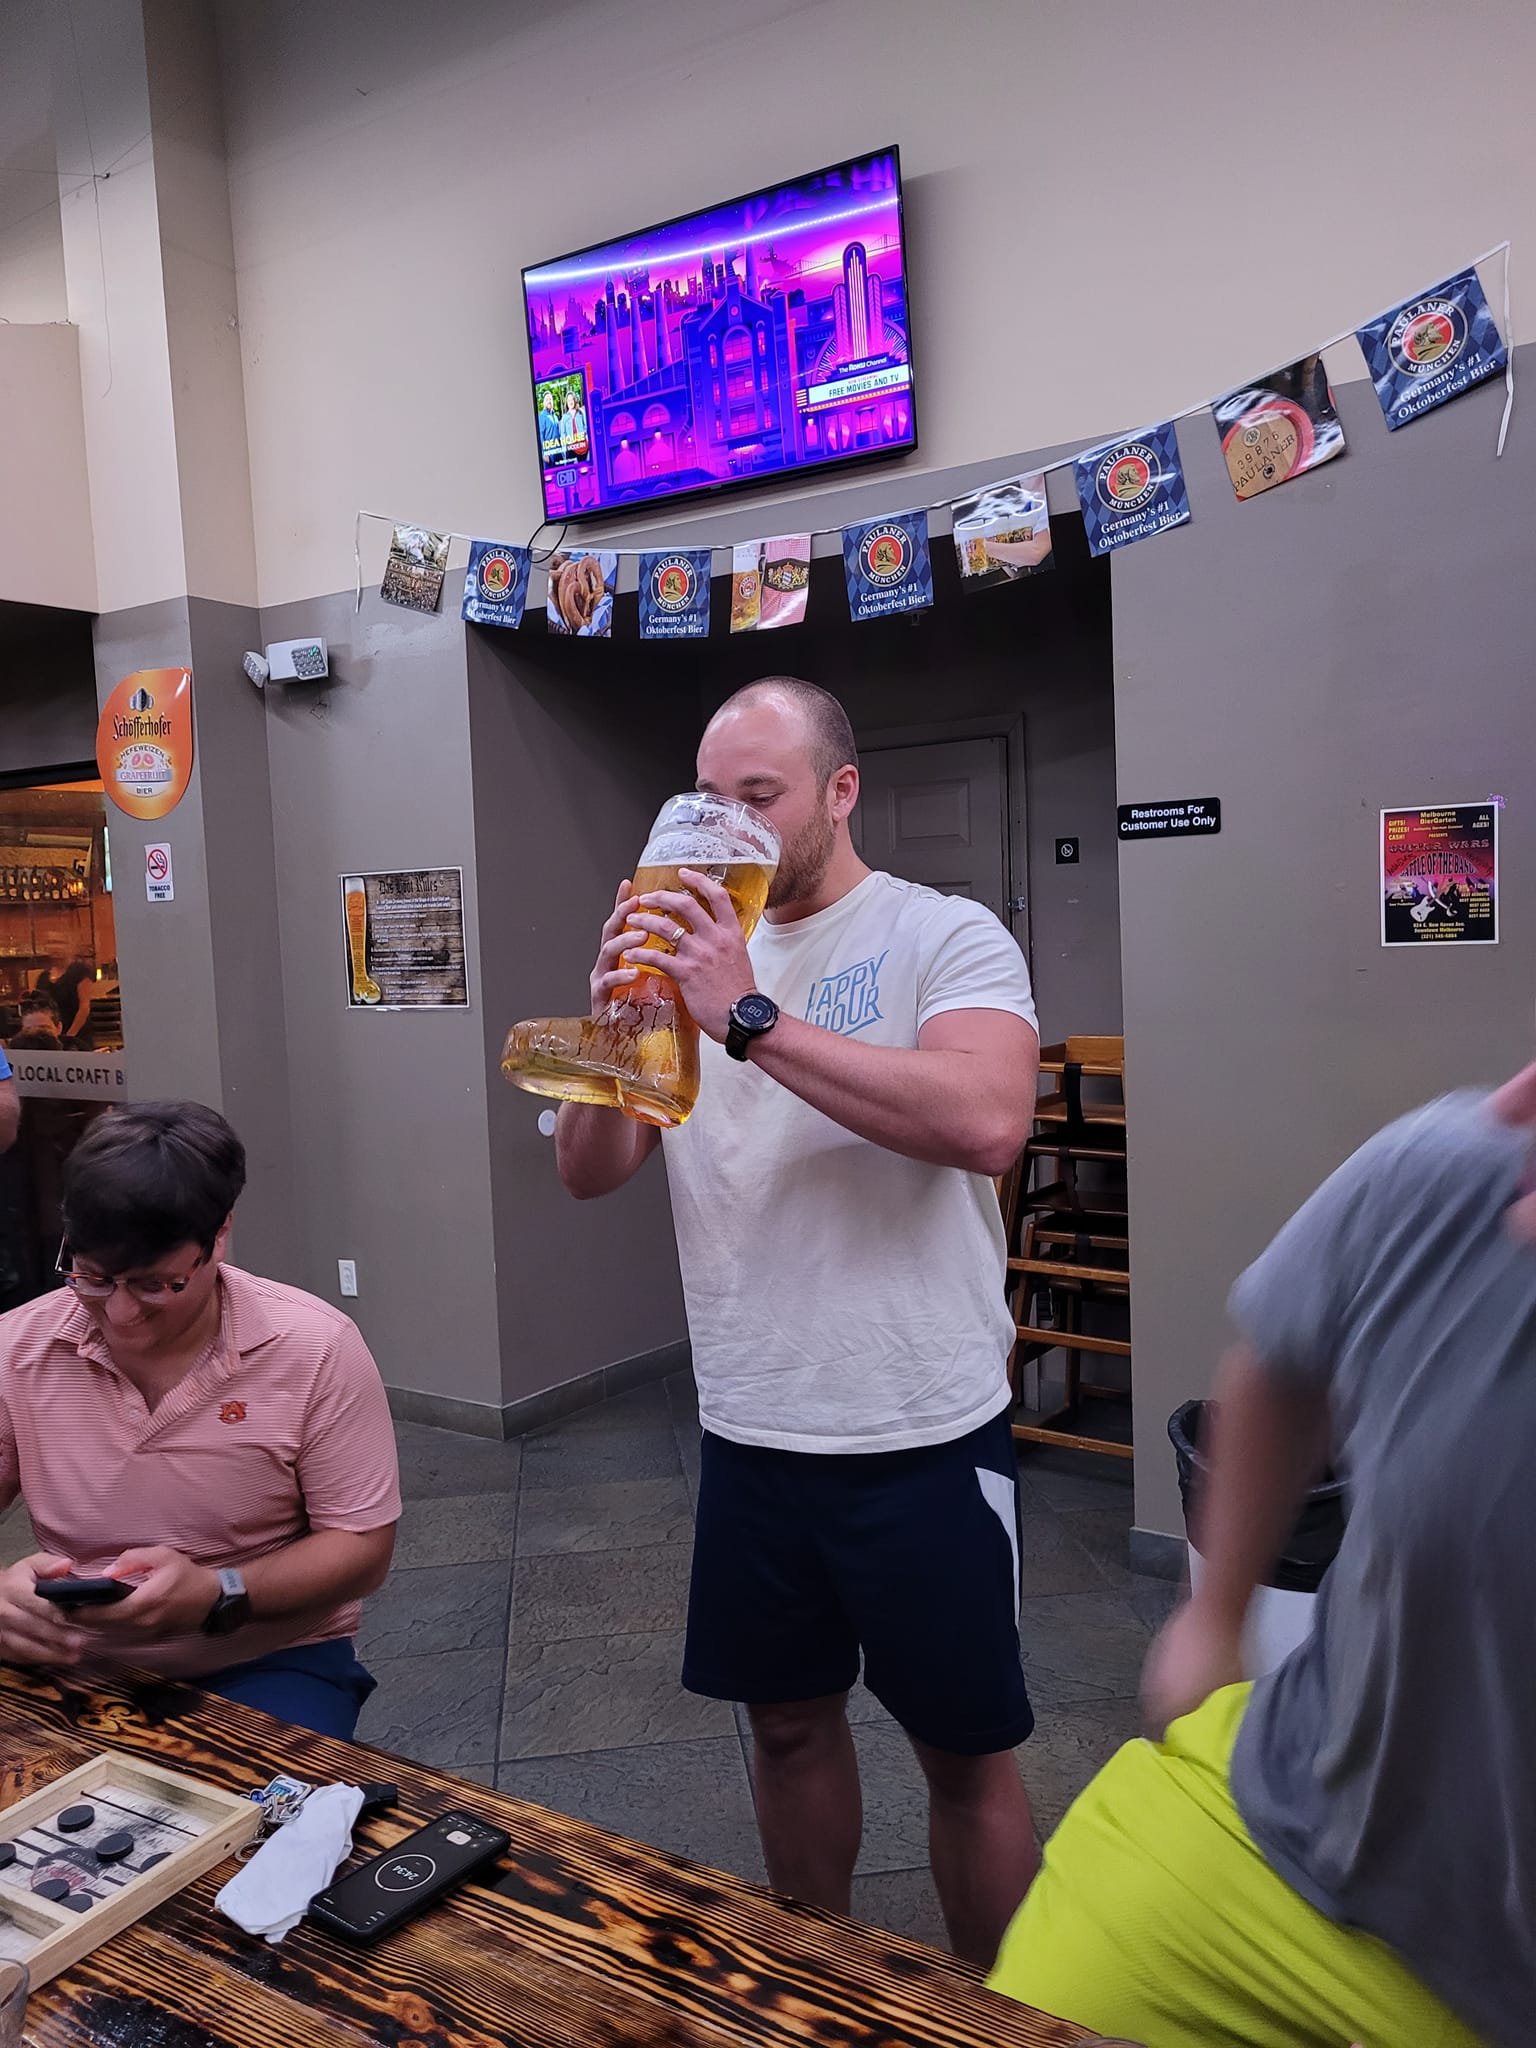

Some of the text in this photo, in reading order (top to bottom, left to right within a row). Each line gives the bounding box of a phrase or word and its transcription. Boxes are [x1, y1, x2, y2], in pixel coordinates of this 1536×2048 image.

[1391, 302, 1455, 348] PAULANER
[829, 373, 899, 397] FREE MOVIES AND TV
[1400, 353, 1482, 403] Germany's #1
[1398, 359, 1497, 419] Oktoberfest Bier
[543, 432, 586, 449] IDEA HOUSE
[1100, 447, 1153, 480] PAULANER
[1234, 435, 1296, 492] PAULANER
[1101, 501, 1170, 533] Germany's #1
[862, 527, 907, 553] PAULANER
[1099, 512, 1181, 549] Oktoberfest Bier
[481, 551, 515, 571] PAULANER
[654, 558, 693, 579] PAULANER
[861, 583, 918, 603] Germany's #1
[505, 605, 513, 613] #1
[858, 595, 926, 615] Oktoberfest Bier
[503, 614, 517, 625] Bier
[646, 623, 703, 635] Oktoberfest Bier
[649, 613, 697, 625] Germany's #1
[112, 712, 172, 741] Schöfferhofer
[120, 745, 165, 760] HEFEWEIZEN
[120, 771, 166, 781] GRAPEFRUIT
[1131, 804, 1205, 819] Restrooms For
[1420, 811, 1456, 819] Melbourne
[1120, 816, 1217, 831] Customer Use Only
[1427, 853, 1438, 875] OF
[1438, 852, 1453, 875] THE
[18, 1065, 63, 1083] LOCAL
[65, 1067, 110, 1085] CRAFT
